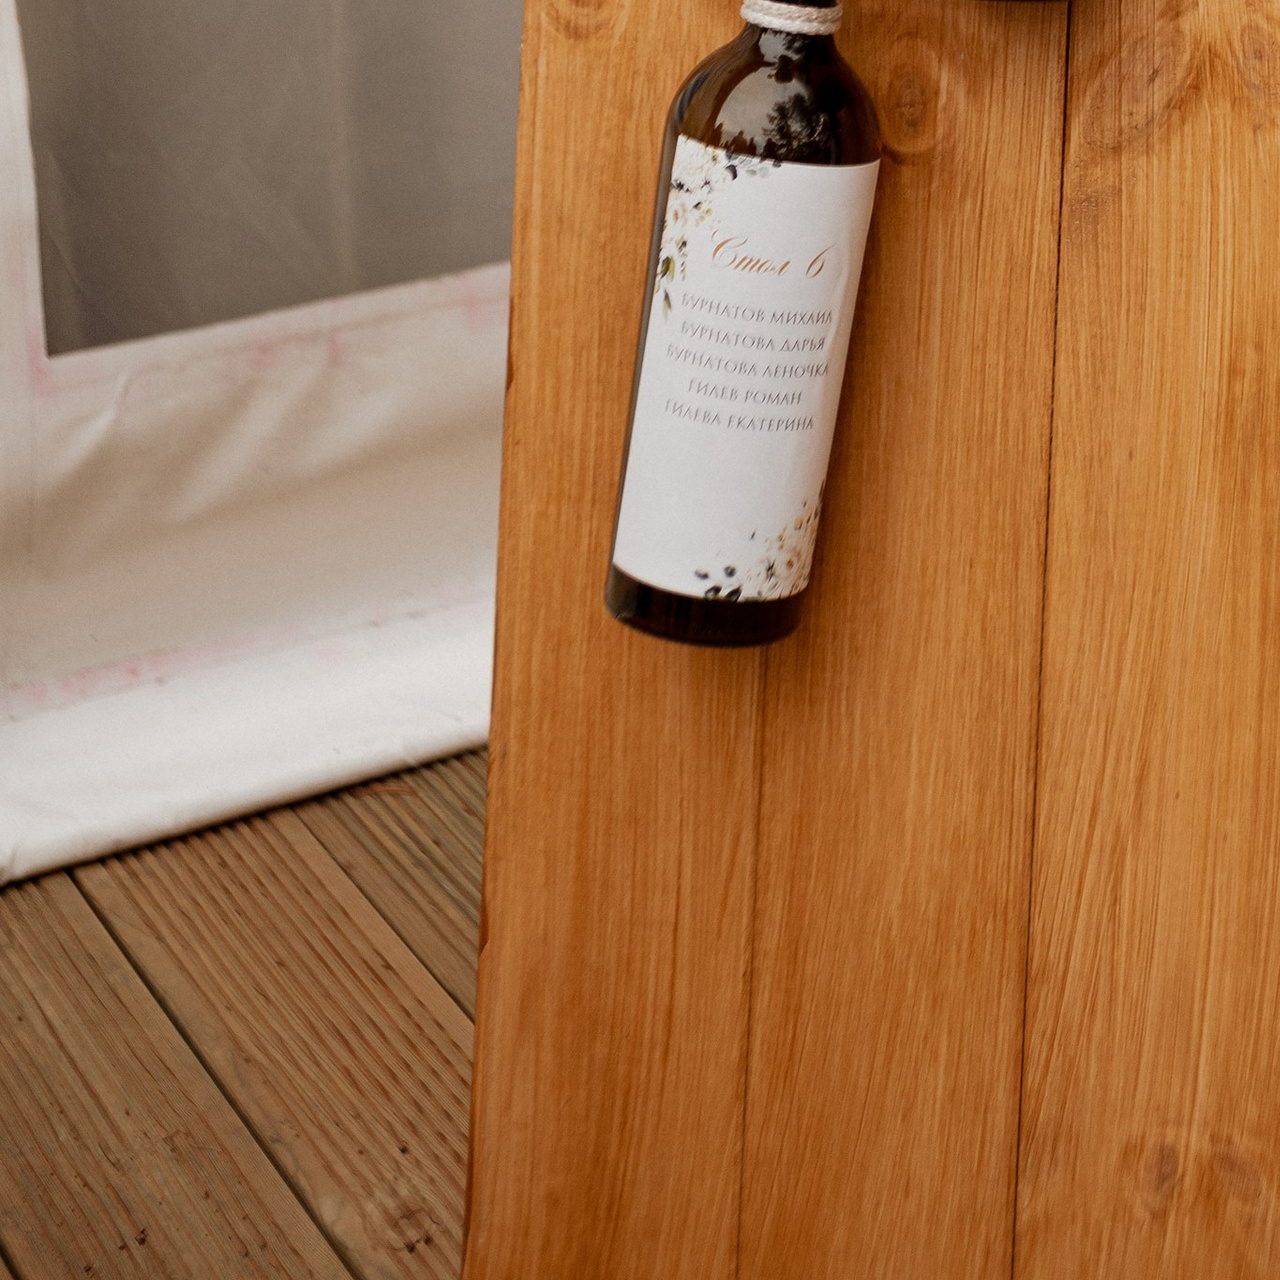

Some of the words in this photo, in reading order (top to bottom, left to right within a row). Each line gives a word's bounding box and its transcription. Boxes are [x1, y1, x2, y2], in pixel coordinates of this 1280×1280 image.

[711, 229, 792, 277] Стол
[805, 244, 835, 279] 6
[681, 292, 766, 323] БУРНАТОВ
[770, 309, 833, 326] МИХАИЛ
[680, 320, 774, 351] БУРНАТОВА
[779, 337, 826, 353] ДАРЬЯ
[666, 343, 757, 377] БУРНАТОВА
[762, 363, 829, 379] ЛЕНОЧКА
[744, 390, 802, 406] РОМАН
[727, 414, 814, 432] ЕКАТЕРИНА
